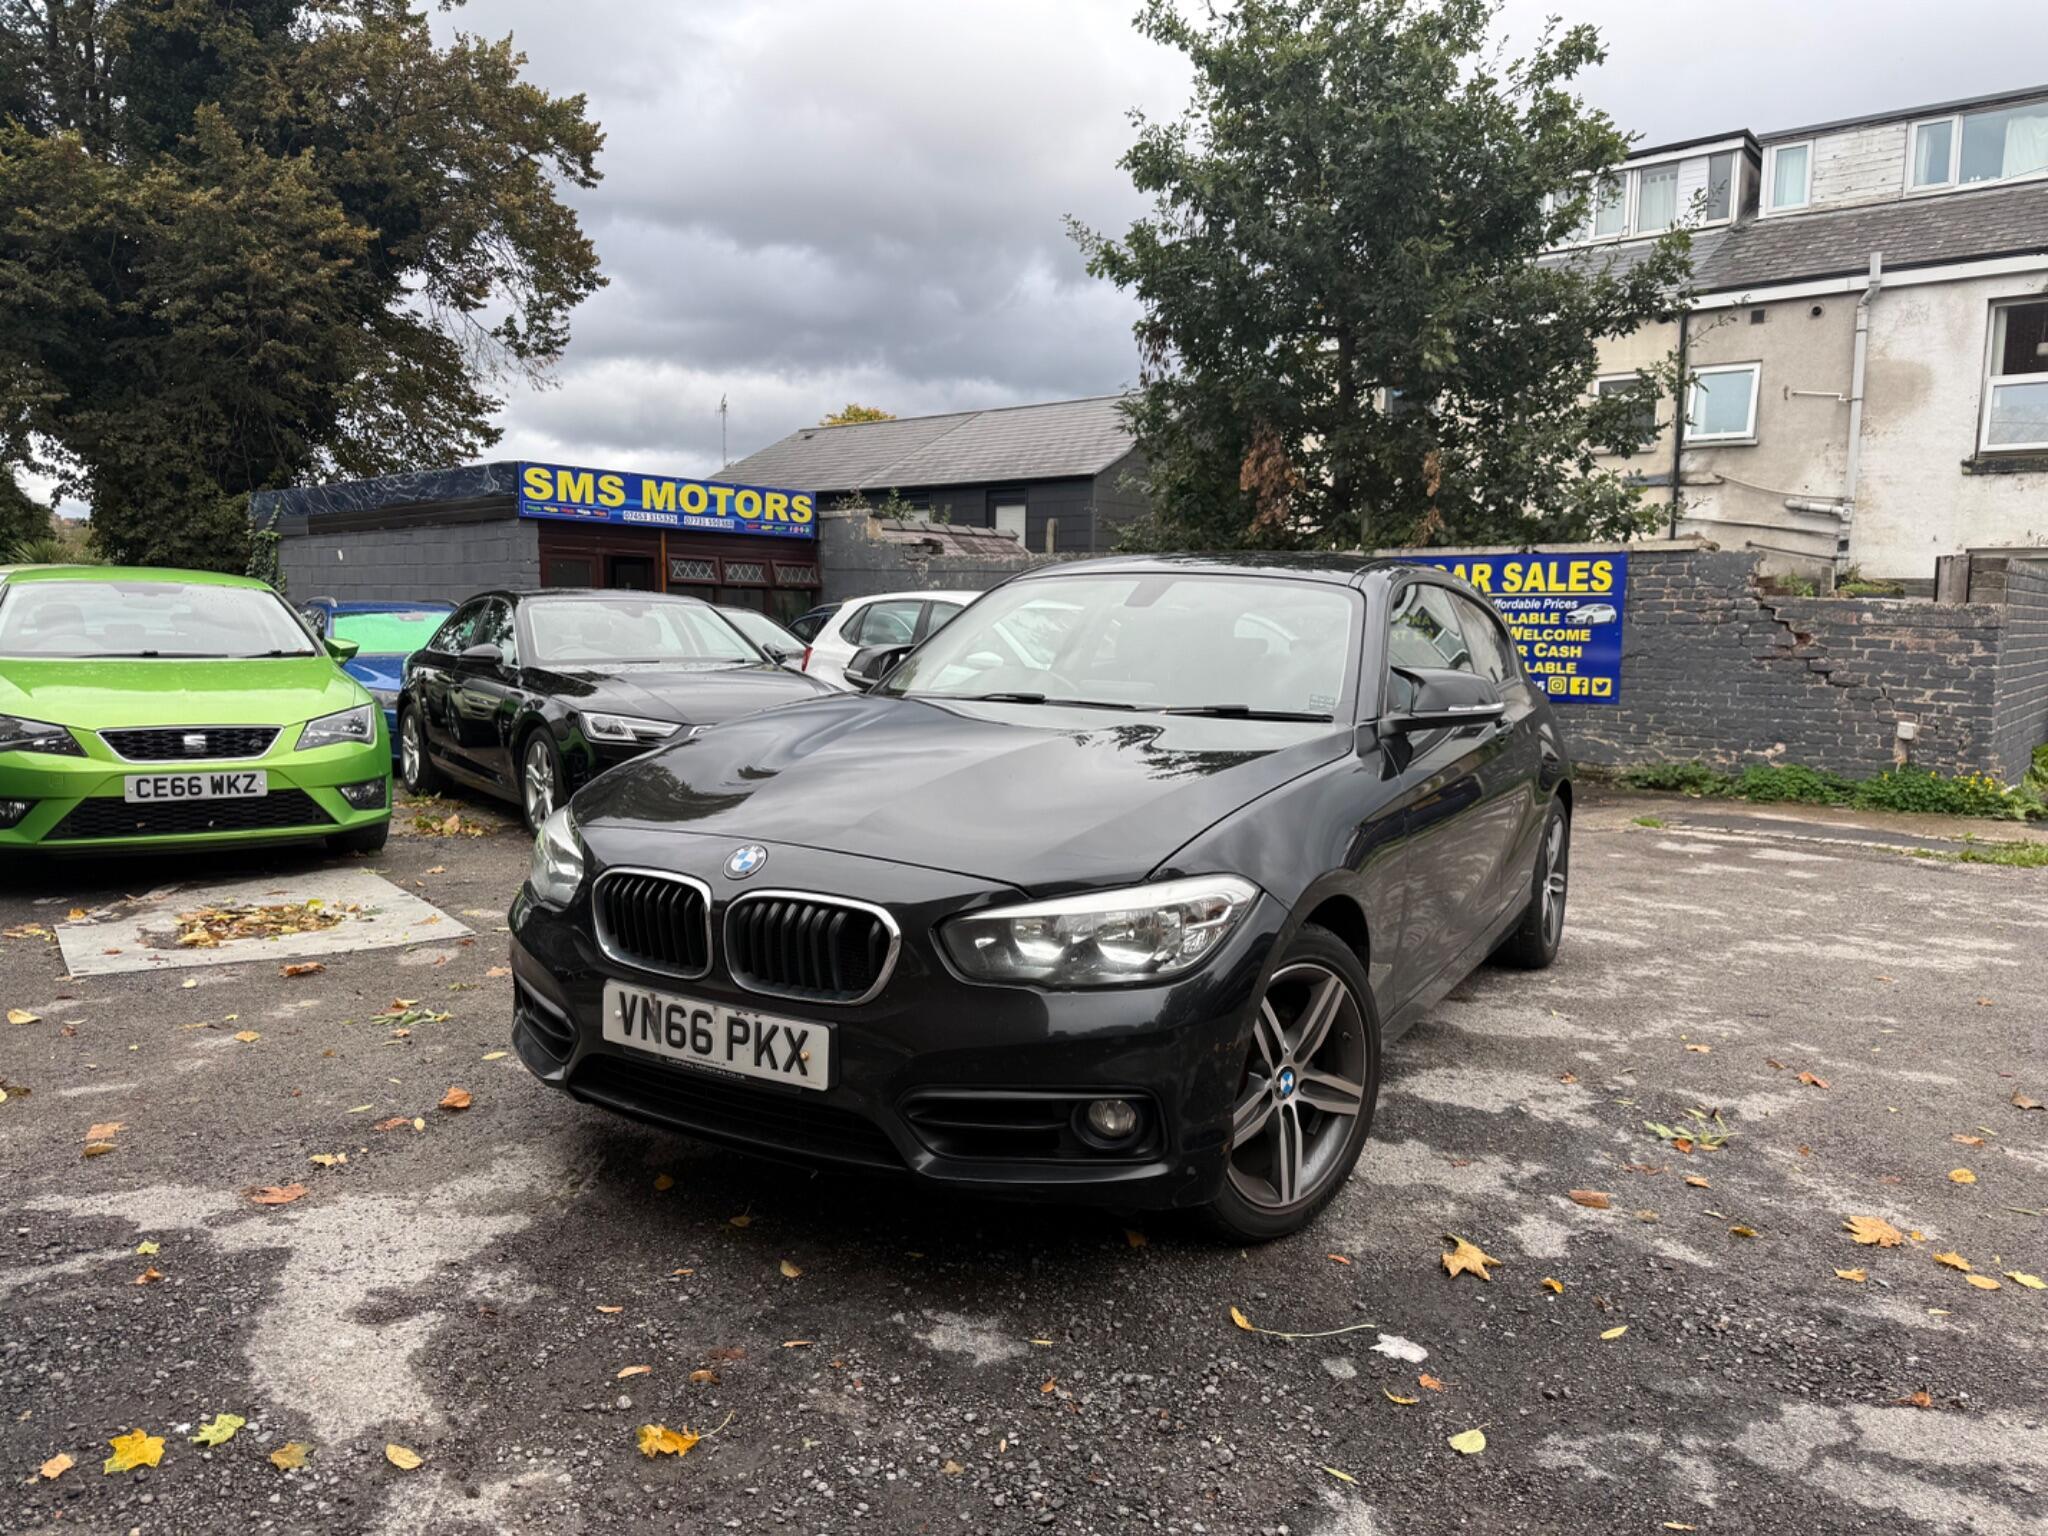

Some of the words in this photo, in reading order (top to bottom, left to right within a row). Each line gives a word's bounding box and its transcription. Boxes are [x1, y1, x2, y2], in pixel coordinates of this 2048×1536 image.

[523, 467, 626, 507] SMS
[642, 479, 812, 523] MOTORS
[1434, 564, 1492, 593] AR
[1502, 560, 1613, 593] SALES
[1493, 598, 1541, 609] ffordable
[1543, 598, 1578, 609] Prices
[1503, 612, 1560, 625] ILABLE
[1510, 626, 1591, 641] WELCOME
[1516, 645, 1528, 657] R
[1533, 642, 1582, 657] CASH
[1523, 661, 1577, 674] LABLE
[136, 776, 202, 799] CE66
[210, 774, 257, 795] WKZ
[619, 991, 713, 1056] VN66
[726, 1015, 809, 1076] PKX
